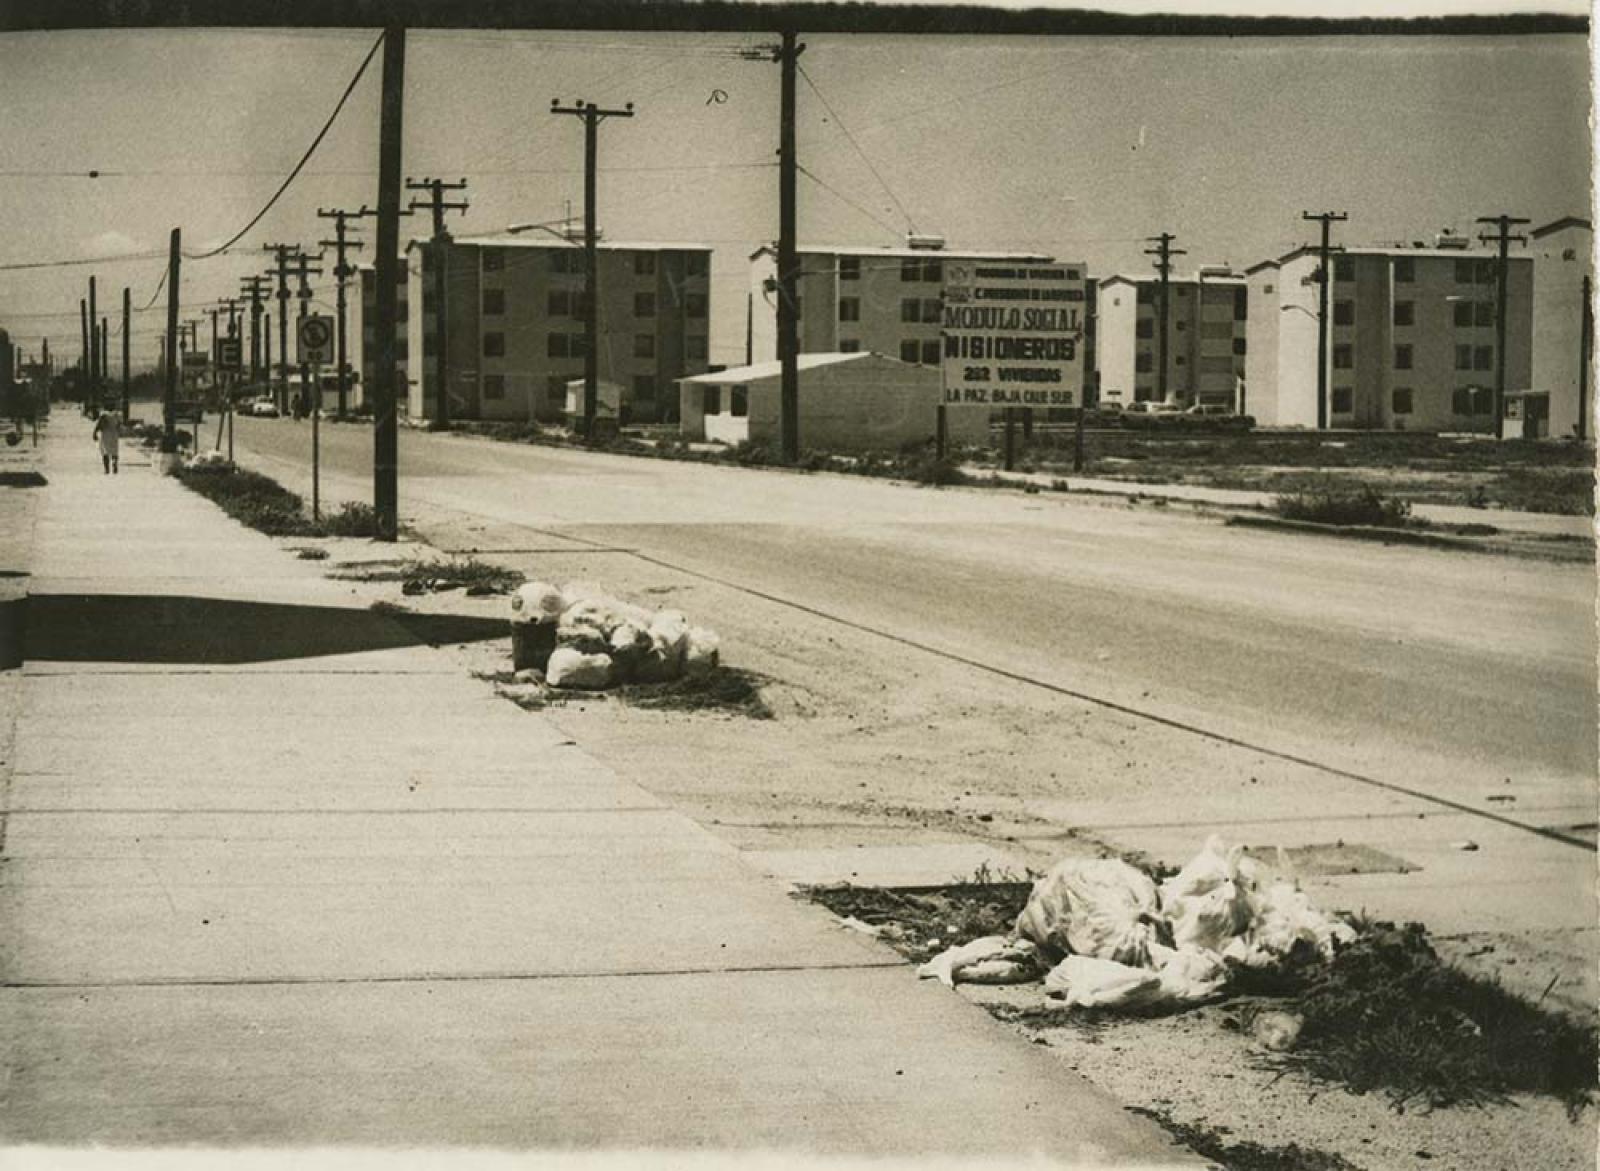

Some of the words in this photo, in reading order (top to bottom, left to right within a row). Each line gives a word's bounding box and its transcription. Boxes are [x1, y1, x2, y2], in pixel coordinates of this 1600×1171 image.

[944, 306, 1019, 329] MODULO
[1022, 308, 1078, 330] SOCIAL
[947, 388, 961, 403] LA
[992, 389, 1022, 404] BAJA
